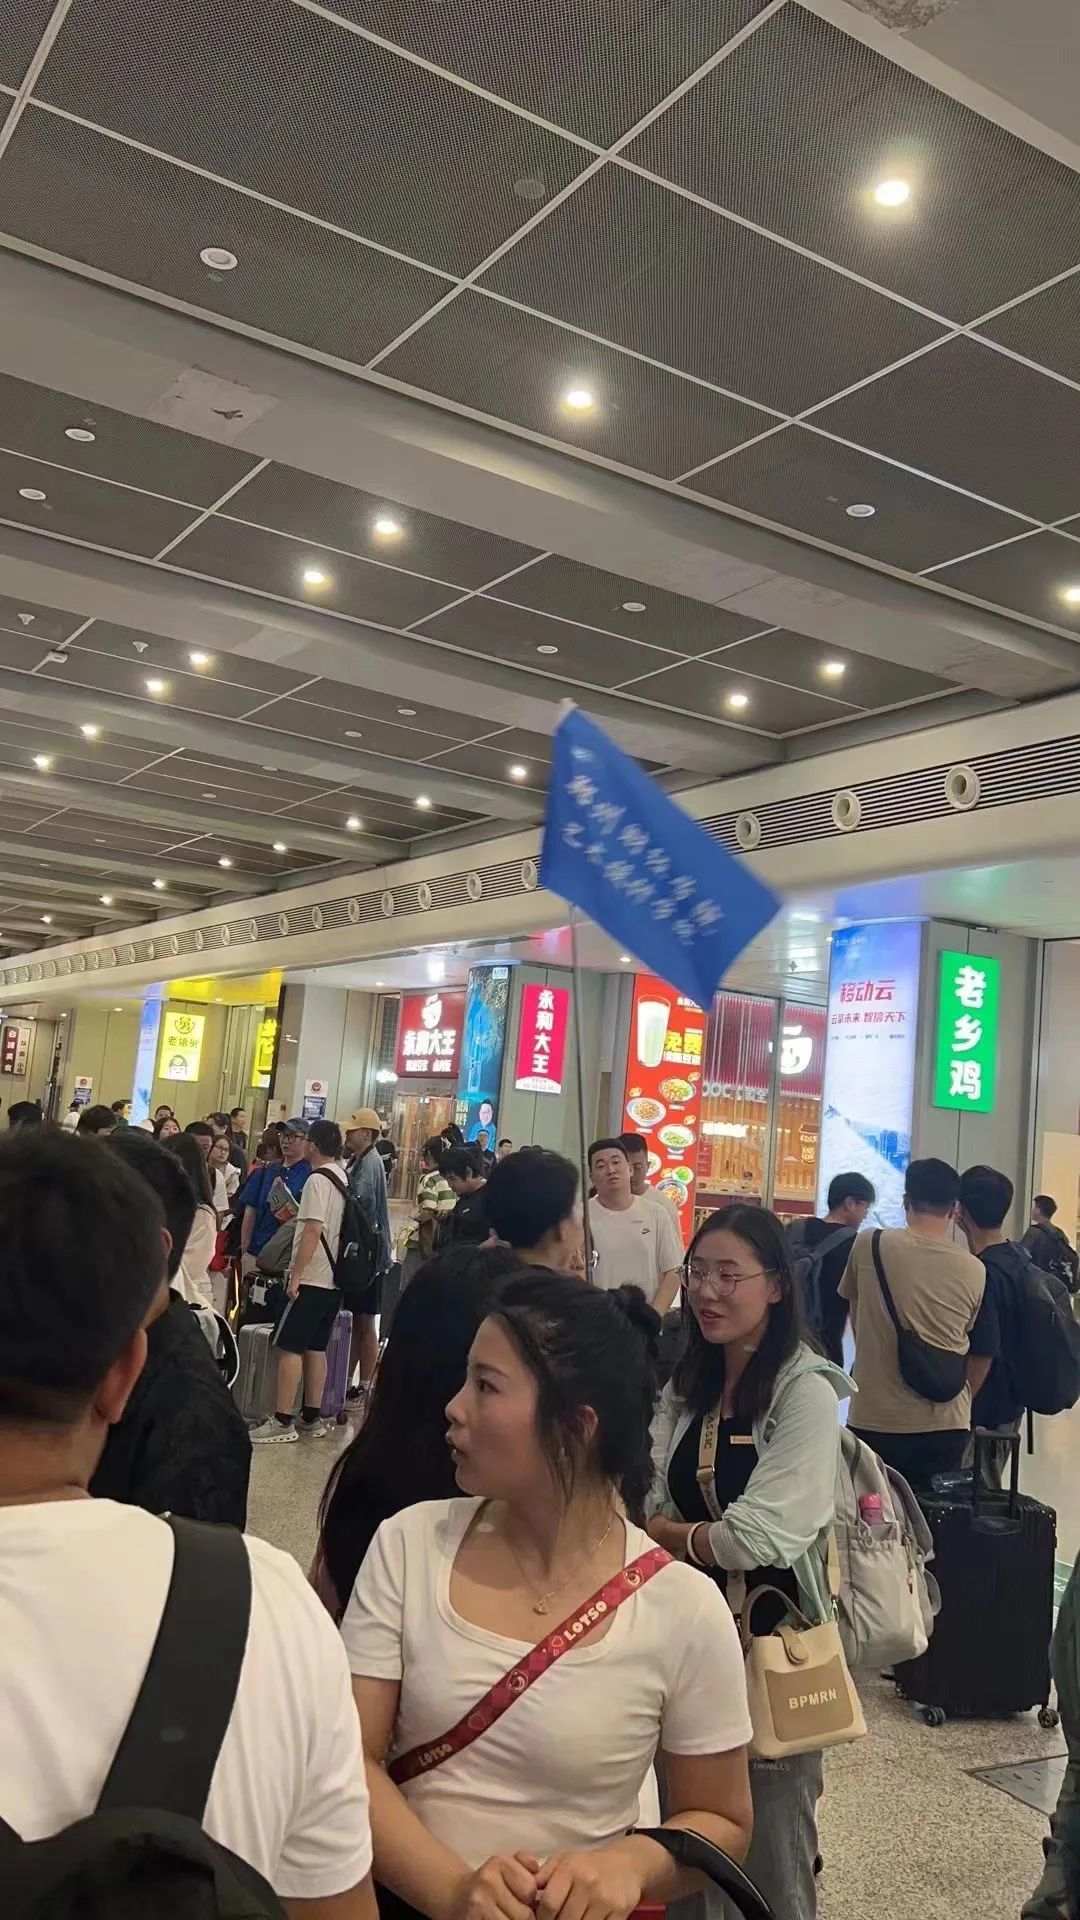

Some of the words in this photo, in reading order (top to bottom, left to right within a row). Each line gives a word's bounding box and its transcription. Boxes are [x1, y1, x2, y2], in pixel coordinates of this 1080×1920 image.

[839, 979, 896, 1003] 移动云
[863, 1011, 907, 1023] 智信天下
[167, 1035, 200, 1050] 老娘舅
[402, 1028, 457, 1057] 永和大王
[531, 989, 555, 1074] 永和大王
[664, 1029, 703, 1056] 免费
[949, 965, 987, 1101] 老乡鸡
[563, 1599, 608, 1641] LOTSO
[788, 1687, 837, 1710] BPMRN
[418, 1742, 453, 1767] LOTSO
